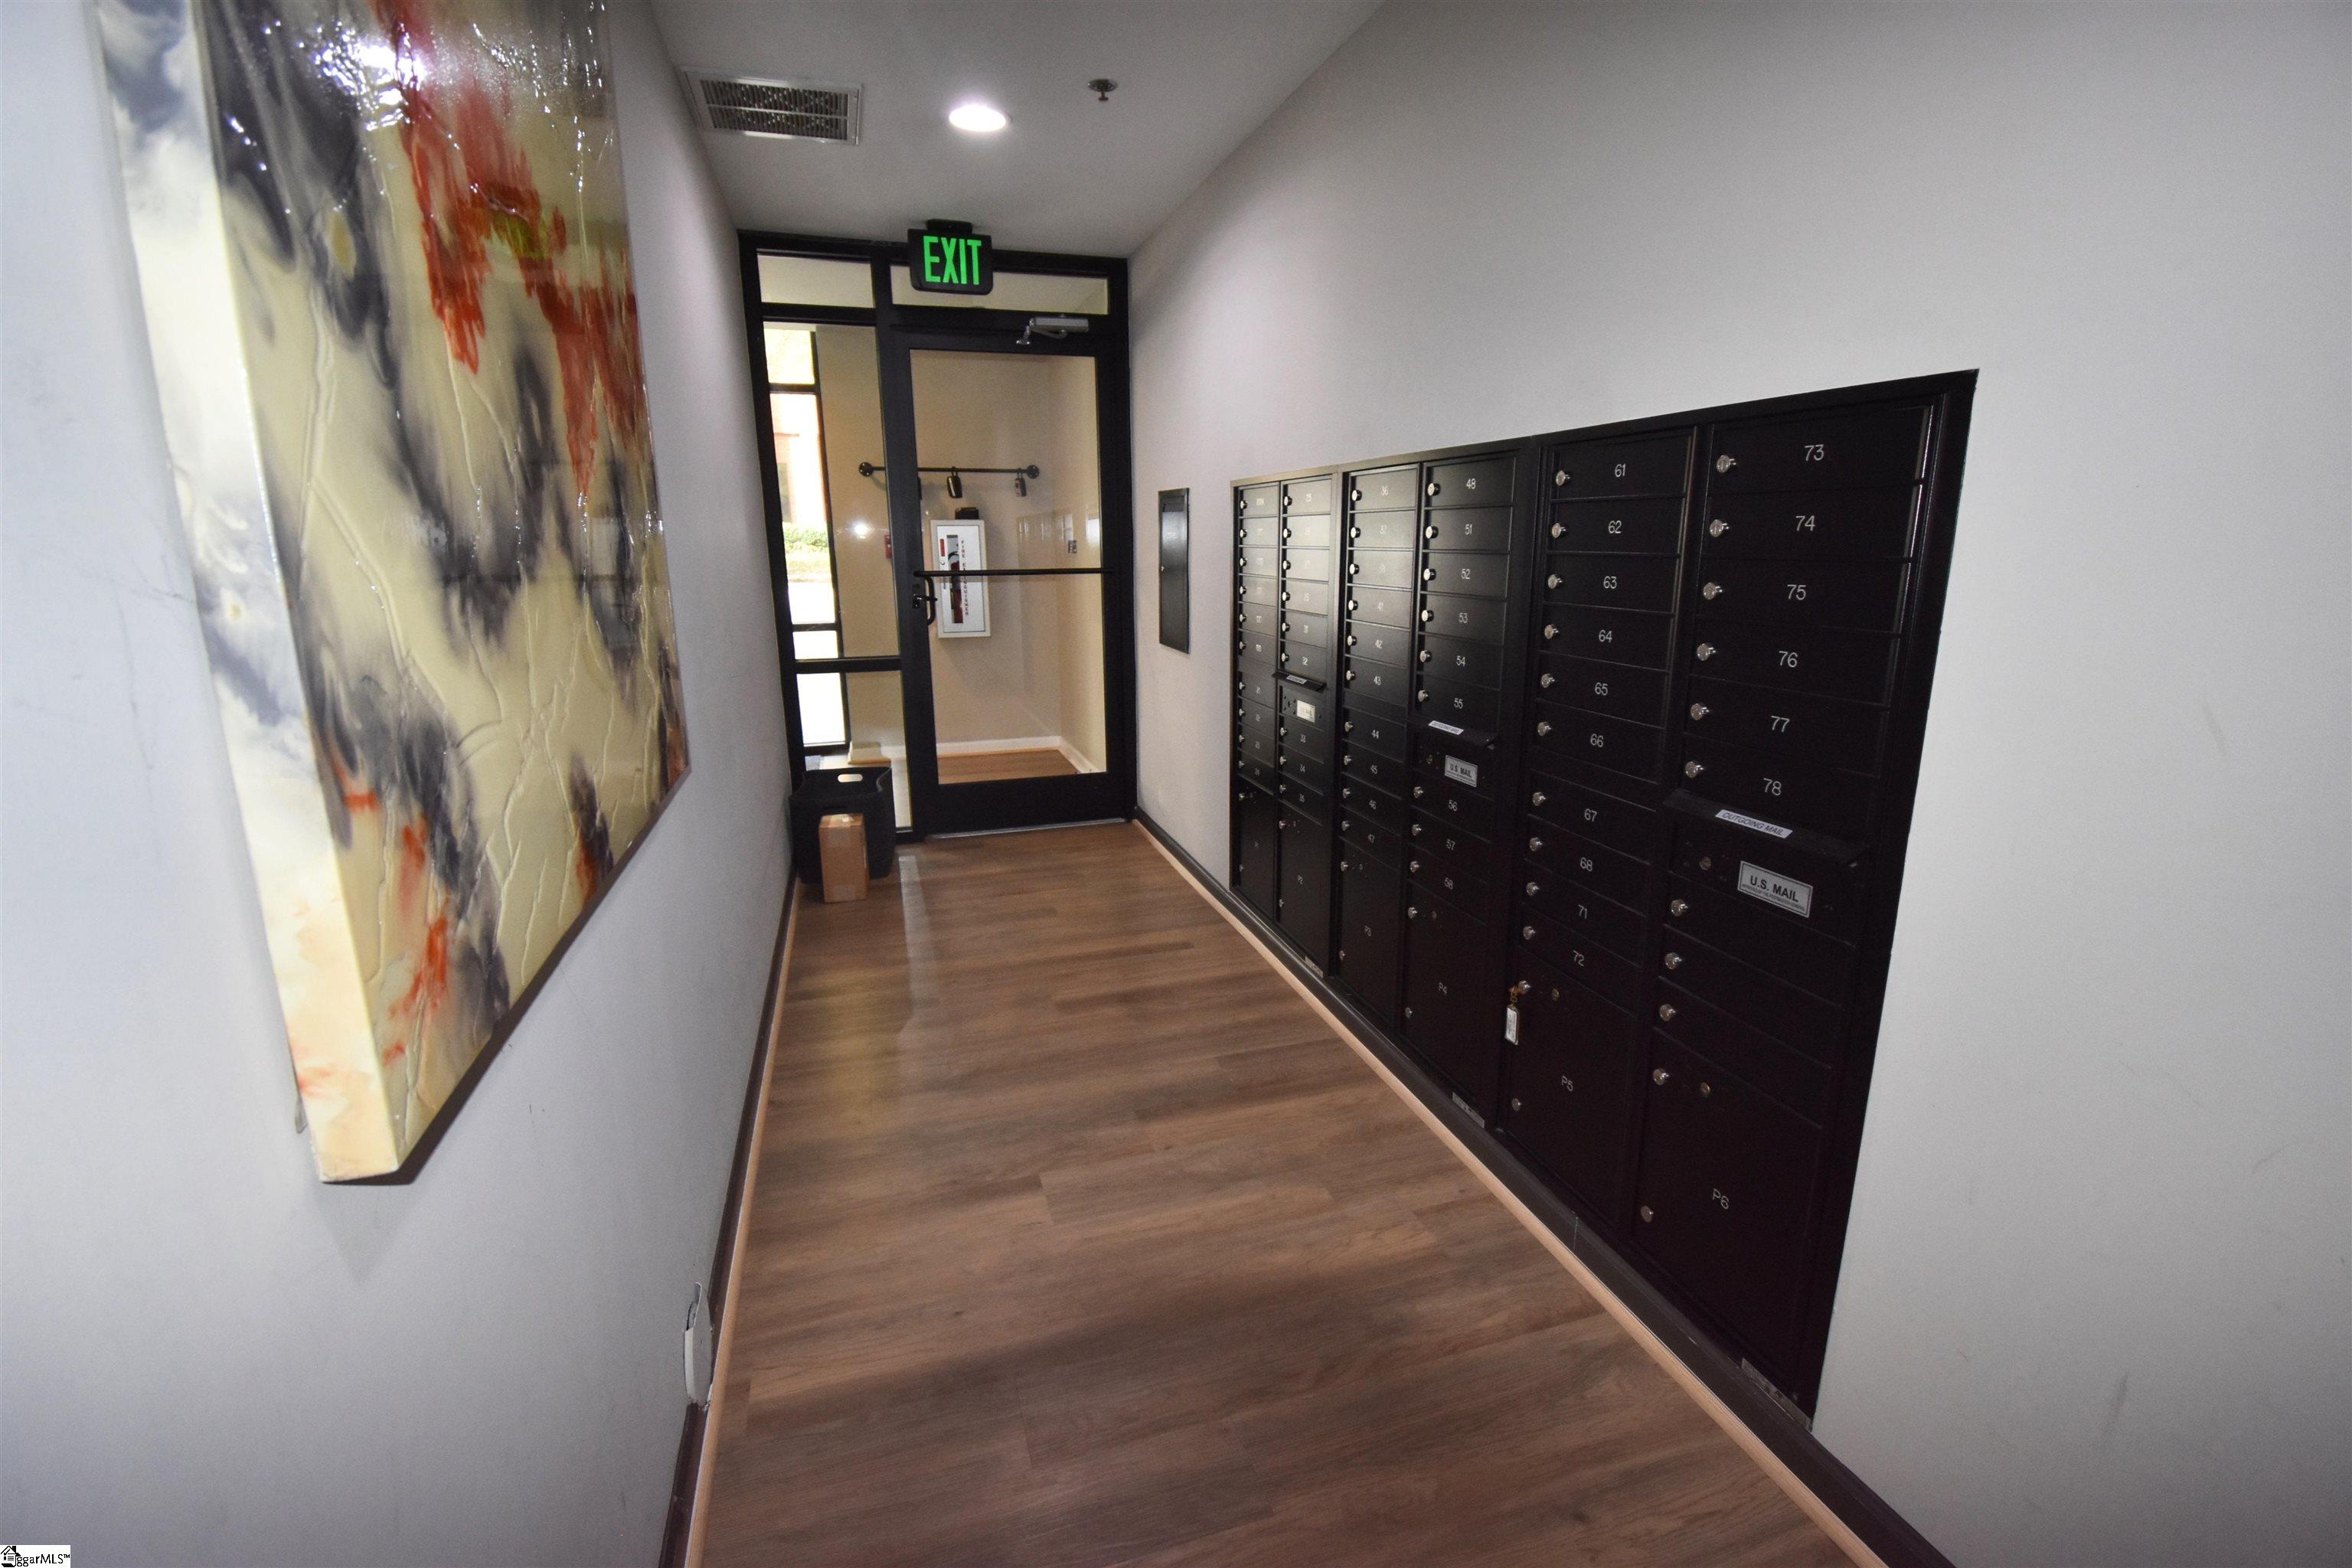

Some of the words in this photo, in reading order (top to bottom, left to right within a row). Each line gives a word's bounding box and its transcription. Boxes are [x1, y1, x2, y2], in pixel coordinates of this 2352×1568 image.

[923, 235, 982, 286] EXIT
[1805, 444, 1824, 461] 73
[1615, 464, 1625, 477] 61
[1466, 479, 1475, 489] 48
[1465, 524, 1472, 534] 51
[1609, 521, 1622, 534] 62
[1796, 515, 1815, 531] 74
[1462, 569, 1470, 579] 52
[1603, 576, 1617, 589] 63
[1788, 584, 1806, 600] 75
[1459, 612, 1468, 623] 53
[1599, 630, 1612, 642] 64
[1375, 639, 1382, 648] 42
[1456, 655, 1465, 666] 54
[1779, 651, 1798, 668] 76
[1374, 676, 1380, 685] 43
[1595, 682, 1608, 695] 65
[1454, 698, 1463, 709] 55
[1771, 716, 1789, 732] 77
[1372, 730, 1379, 739] 44
[1590, 733, 1603, 747] 66
[1370, 765, 1377, 774] 45
[1764, 778, 1781, 795] 78
[1369, 800, 1376, 809] 46
[1449, 800, 1457, 811] 56
[1584, 808, 1597, 822] 67
[1723, 812, 1764, 829] OUTGOING
[1764, 825, 1785, 836] MAIL
[1446, 839, 1455, 850] 57
[1580, 858, 1592, 871] 68
[1445, 877, 1452, 889] 58
[1750, 875, 1769, 891] U.S.
[1772, 884, 1798, 902] MAIL
[1578, 905, 1587, 919] 71
[1573, 950, 1584, 966] 72
[1439, 982, 1447, 995] P4
[1562, 1076, 1573, 1091] P5
[1713, 1188, 1729, 1209] P6
